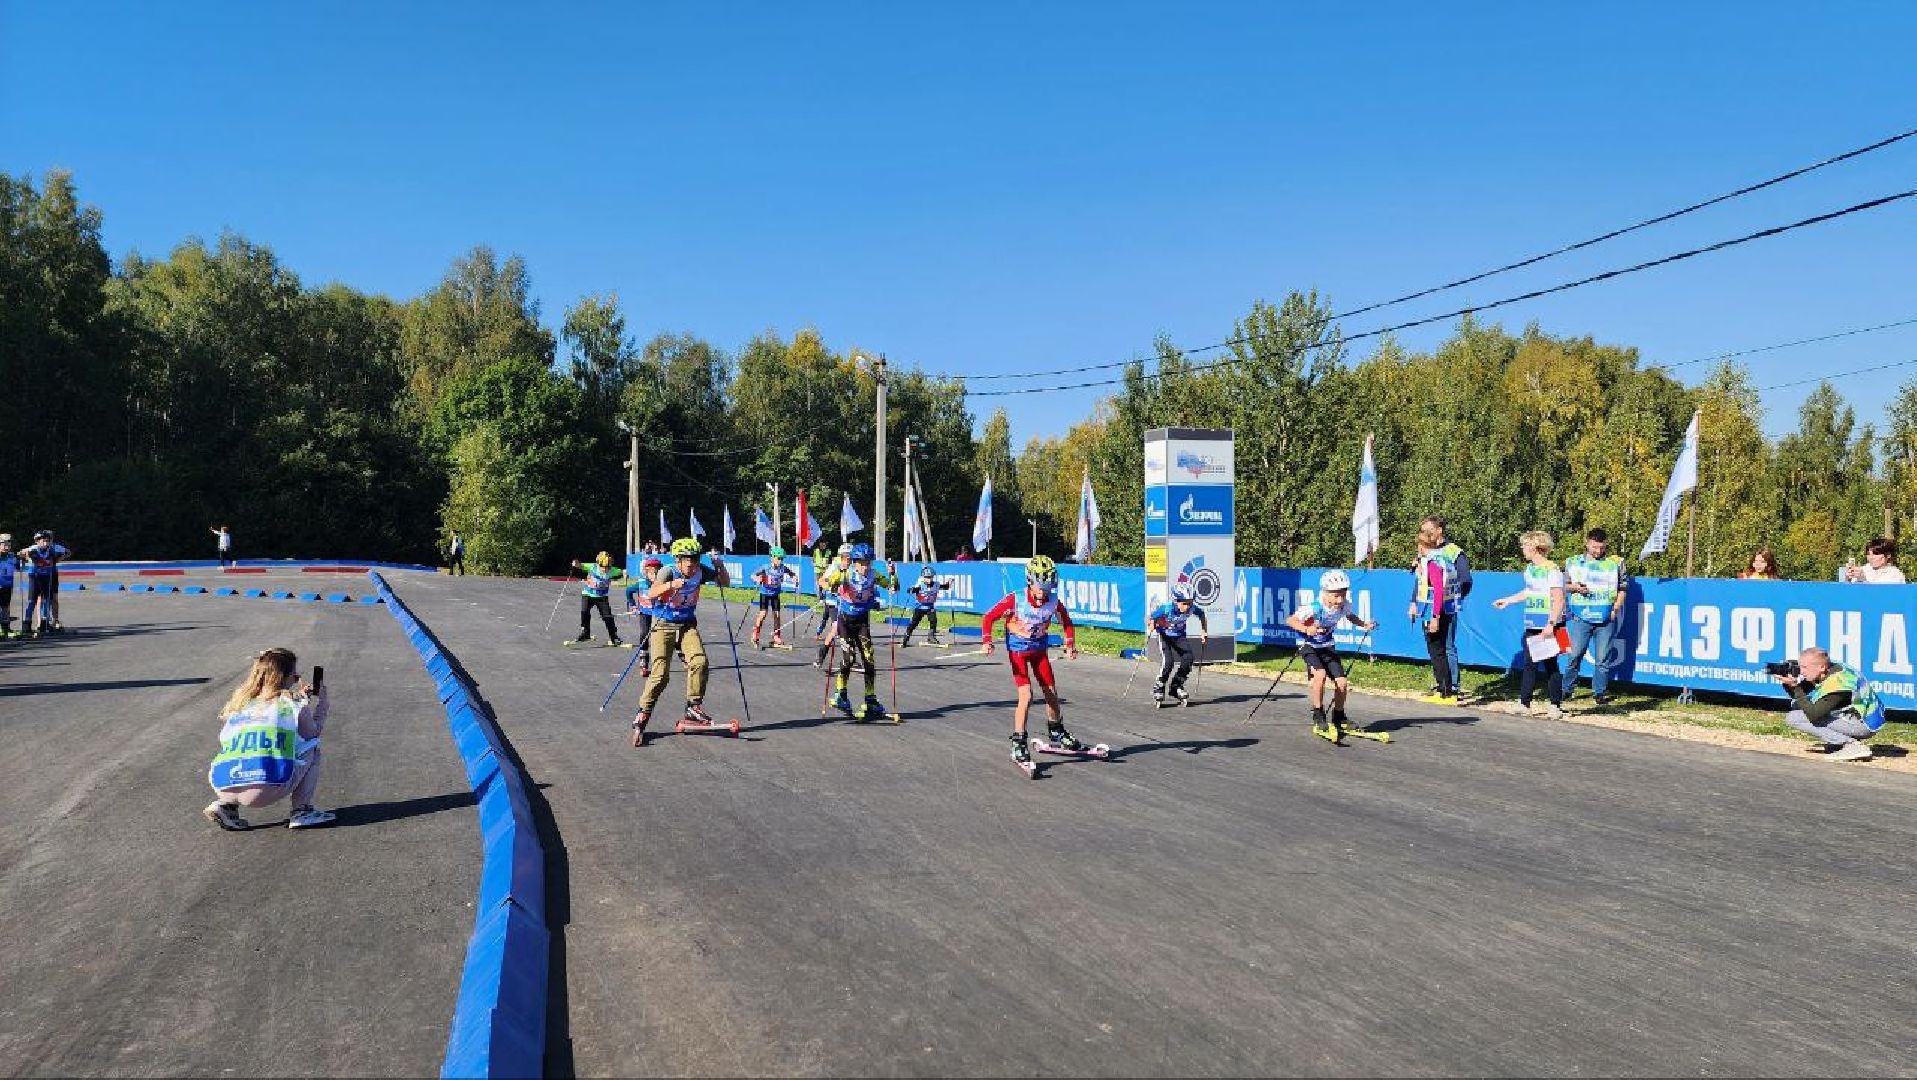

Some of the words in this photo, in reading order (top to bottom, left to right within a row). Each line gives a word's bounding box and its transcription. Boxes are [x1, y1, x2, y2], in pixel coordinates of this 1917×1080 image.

[1635, 602, 1913, 675] ГАЗФОНД
[1635, 660, 1768, 684] НЕГОСУДАРСТВЕННЫЙ
[1872, 680, 1915, 699] ФОНД
[220, 730, 287, 754] УДЬЯ
